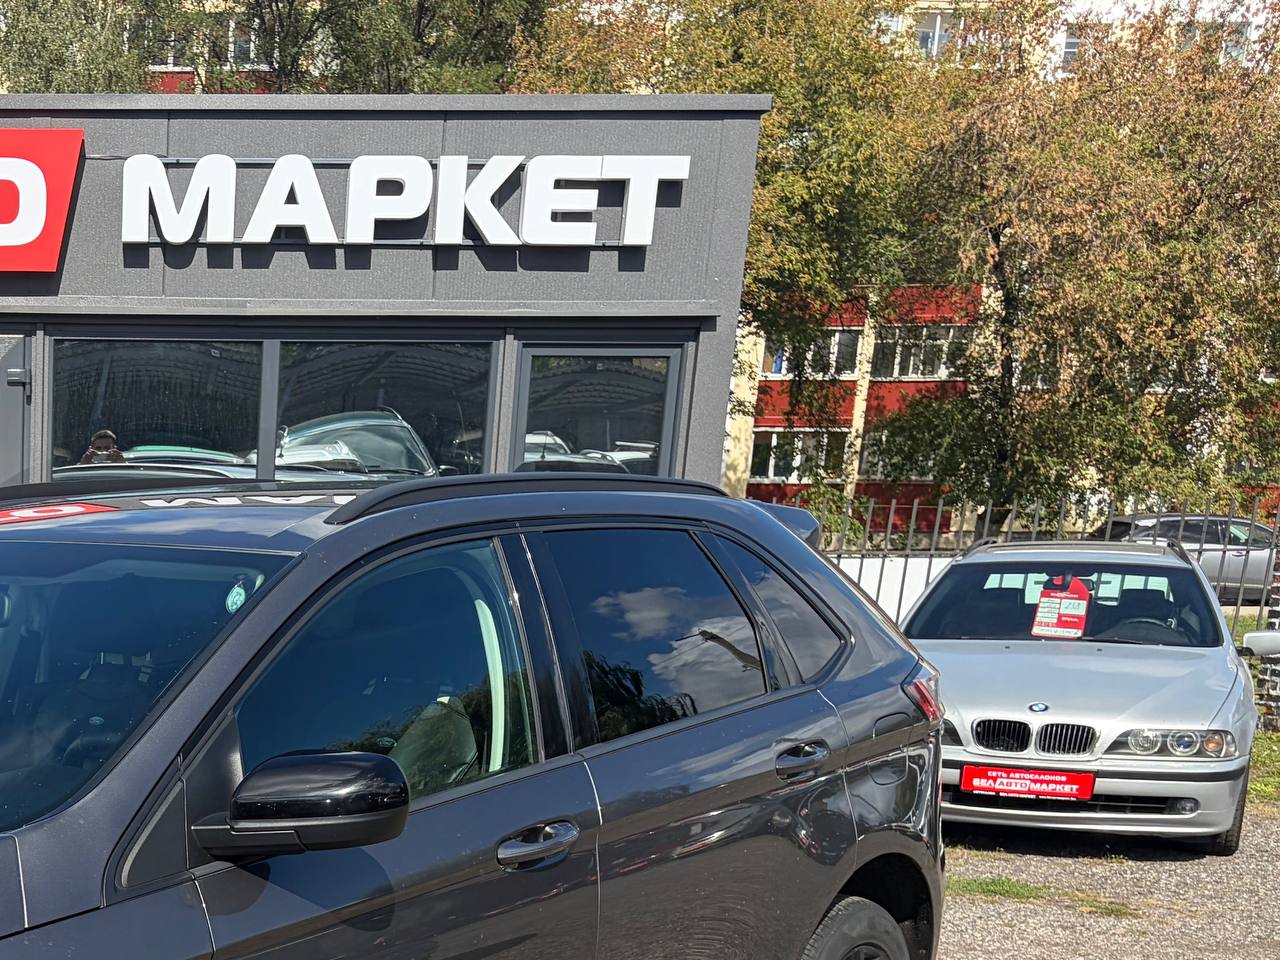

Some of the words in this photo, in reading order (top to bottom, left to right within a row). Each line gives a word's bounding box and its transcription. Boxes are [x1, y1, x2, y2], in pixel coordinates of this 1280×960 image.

[121, 153, 691, 246] МАРКЕТ
[987, 770, 1008, 778] СЕТЬ
[1009, 772, 1067, 782] АВТОСАЛОНОВ
[997, 779, 1028, 789] АВТО
[1029, 782, 1080, 793] МАРКЕТ
